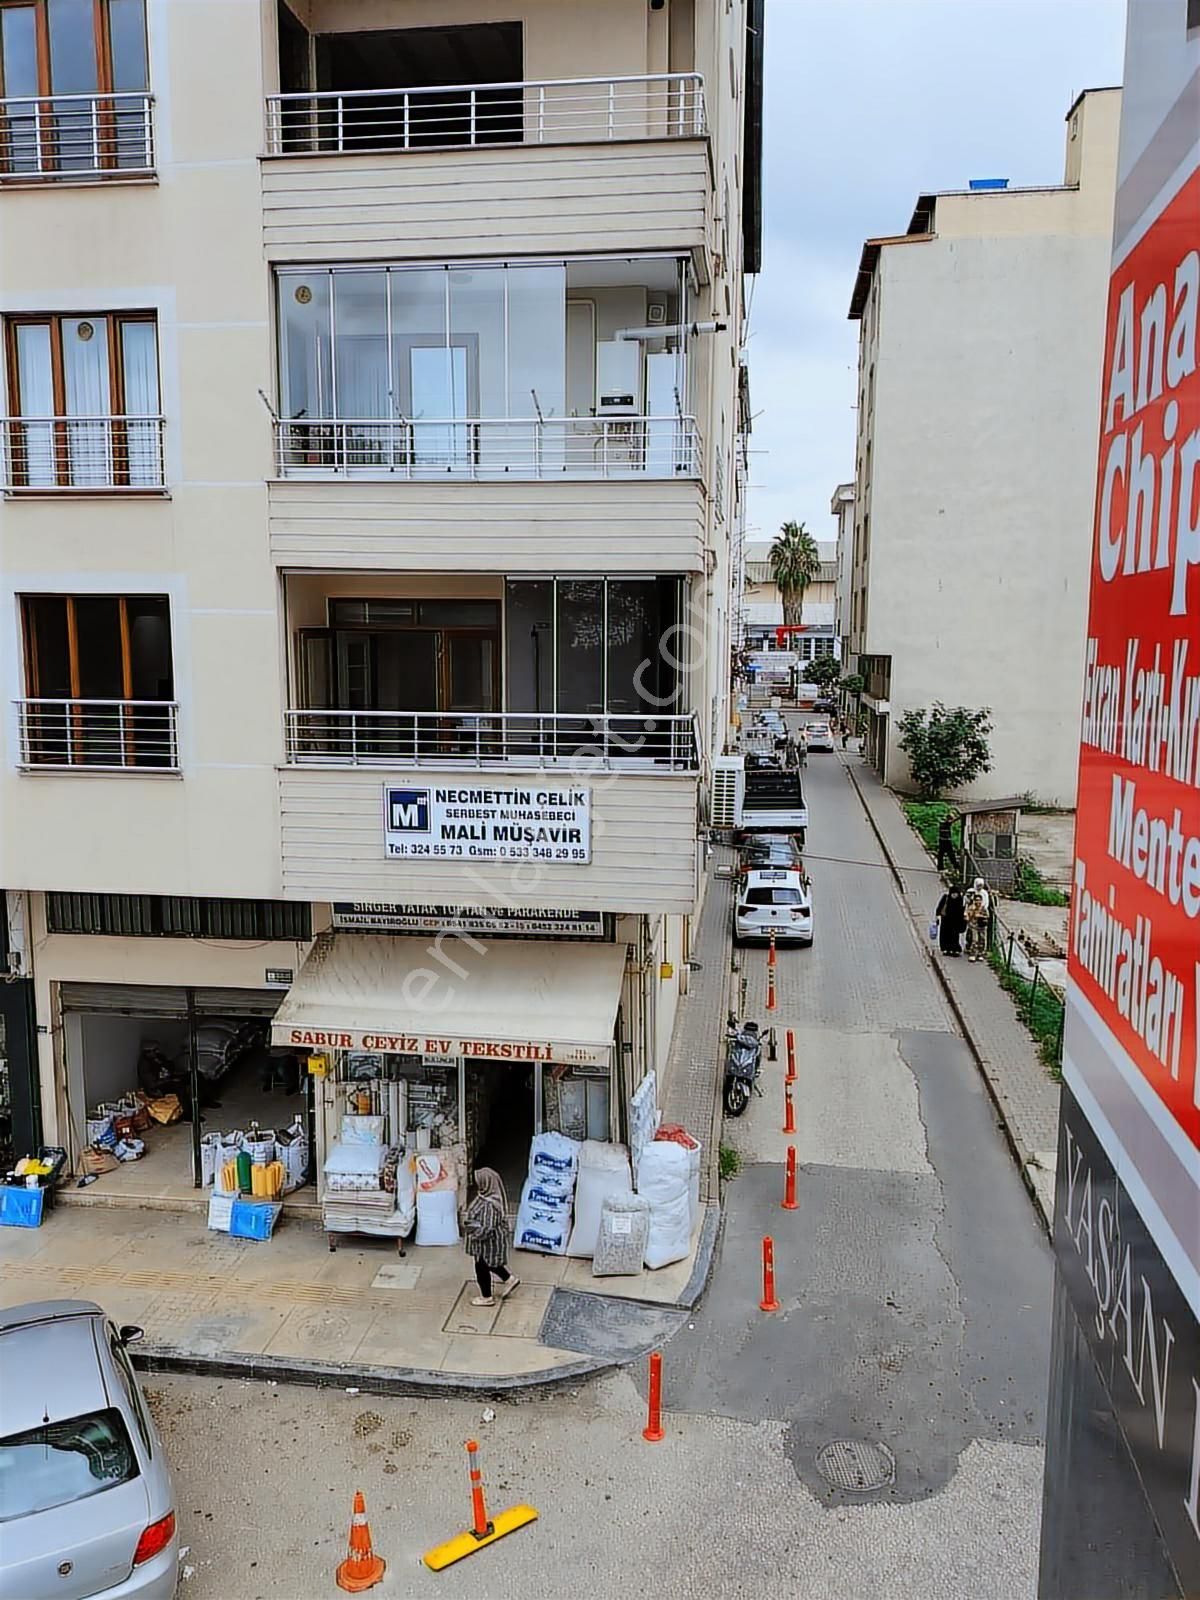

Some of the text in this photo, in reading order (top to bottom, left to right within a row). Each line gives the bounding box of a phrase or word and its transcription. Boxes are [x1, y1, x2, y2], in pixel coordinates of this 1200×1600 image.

[1081, 637, 1200, 789] Ekran Kartı-Kır
[435, 787, 585, 809] NECMETTİN ÇELİK
[446, 808, 497, 819] SERBEST
[441, 821, 582, 846] MALİ MÜŞAVİR
[388, 843, 586, 859] Tel: 324 55 73 Gsm: 0 533 348 29 95
[1073, 857, 1184, 1082] Tamiratları
[290, 1030, 353, 1047] SABUR
[362, 1033, 418, 1052] ÇEYİZ
[425, 1040, 452, 1053] EV
[460, 1041, 553, 1060] TEKSTİLİ
